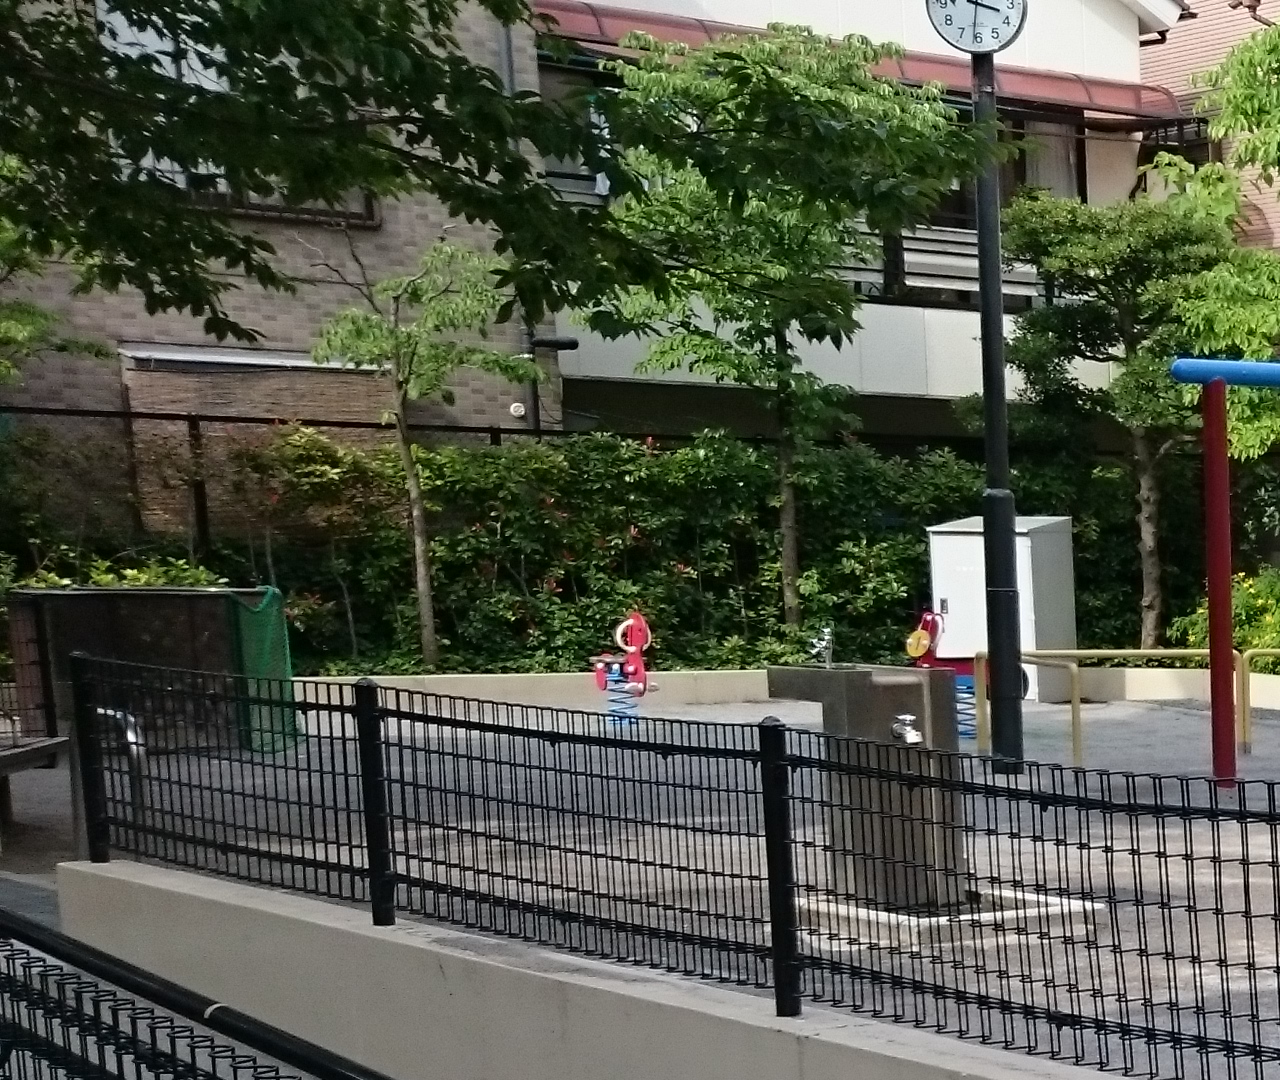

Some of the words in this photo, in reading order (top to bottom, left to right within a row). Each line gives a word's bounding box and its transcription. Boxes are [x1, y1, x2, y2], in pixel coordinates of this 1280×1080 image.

[940, 0, 947, 9] 9
[1007, 0, 1014, 9] 3
[945, 15, 953, 26] 8
[1002, 16, 1011, 27] 4
[958, 27, 965, 39] 7
[975, 32, 983, 44] 6
[991, 28, 999, 39] 5
